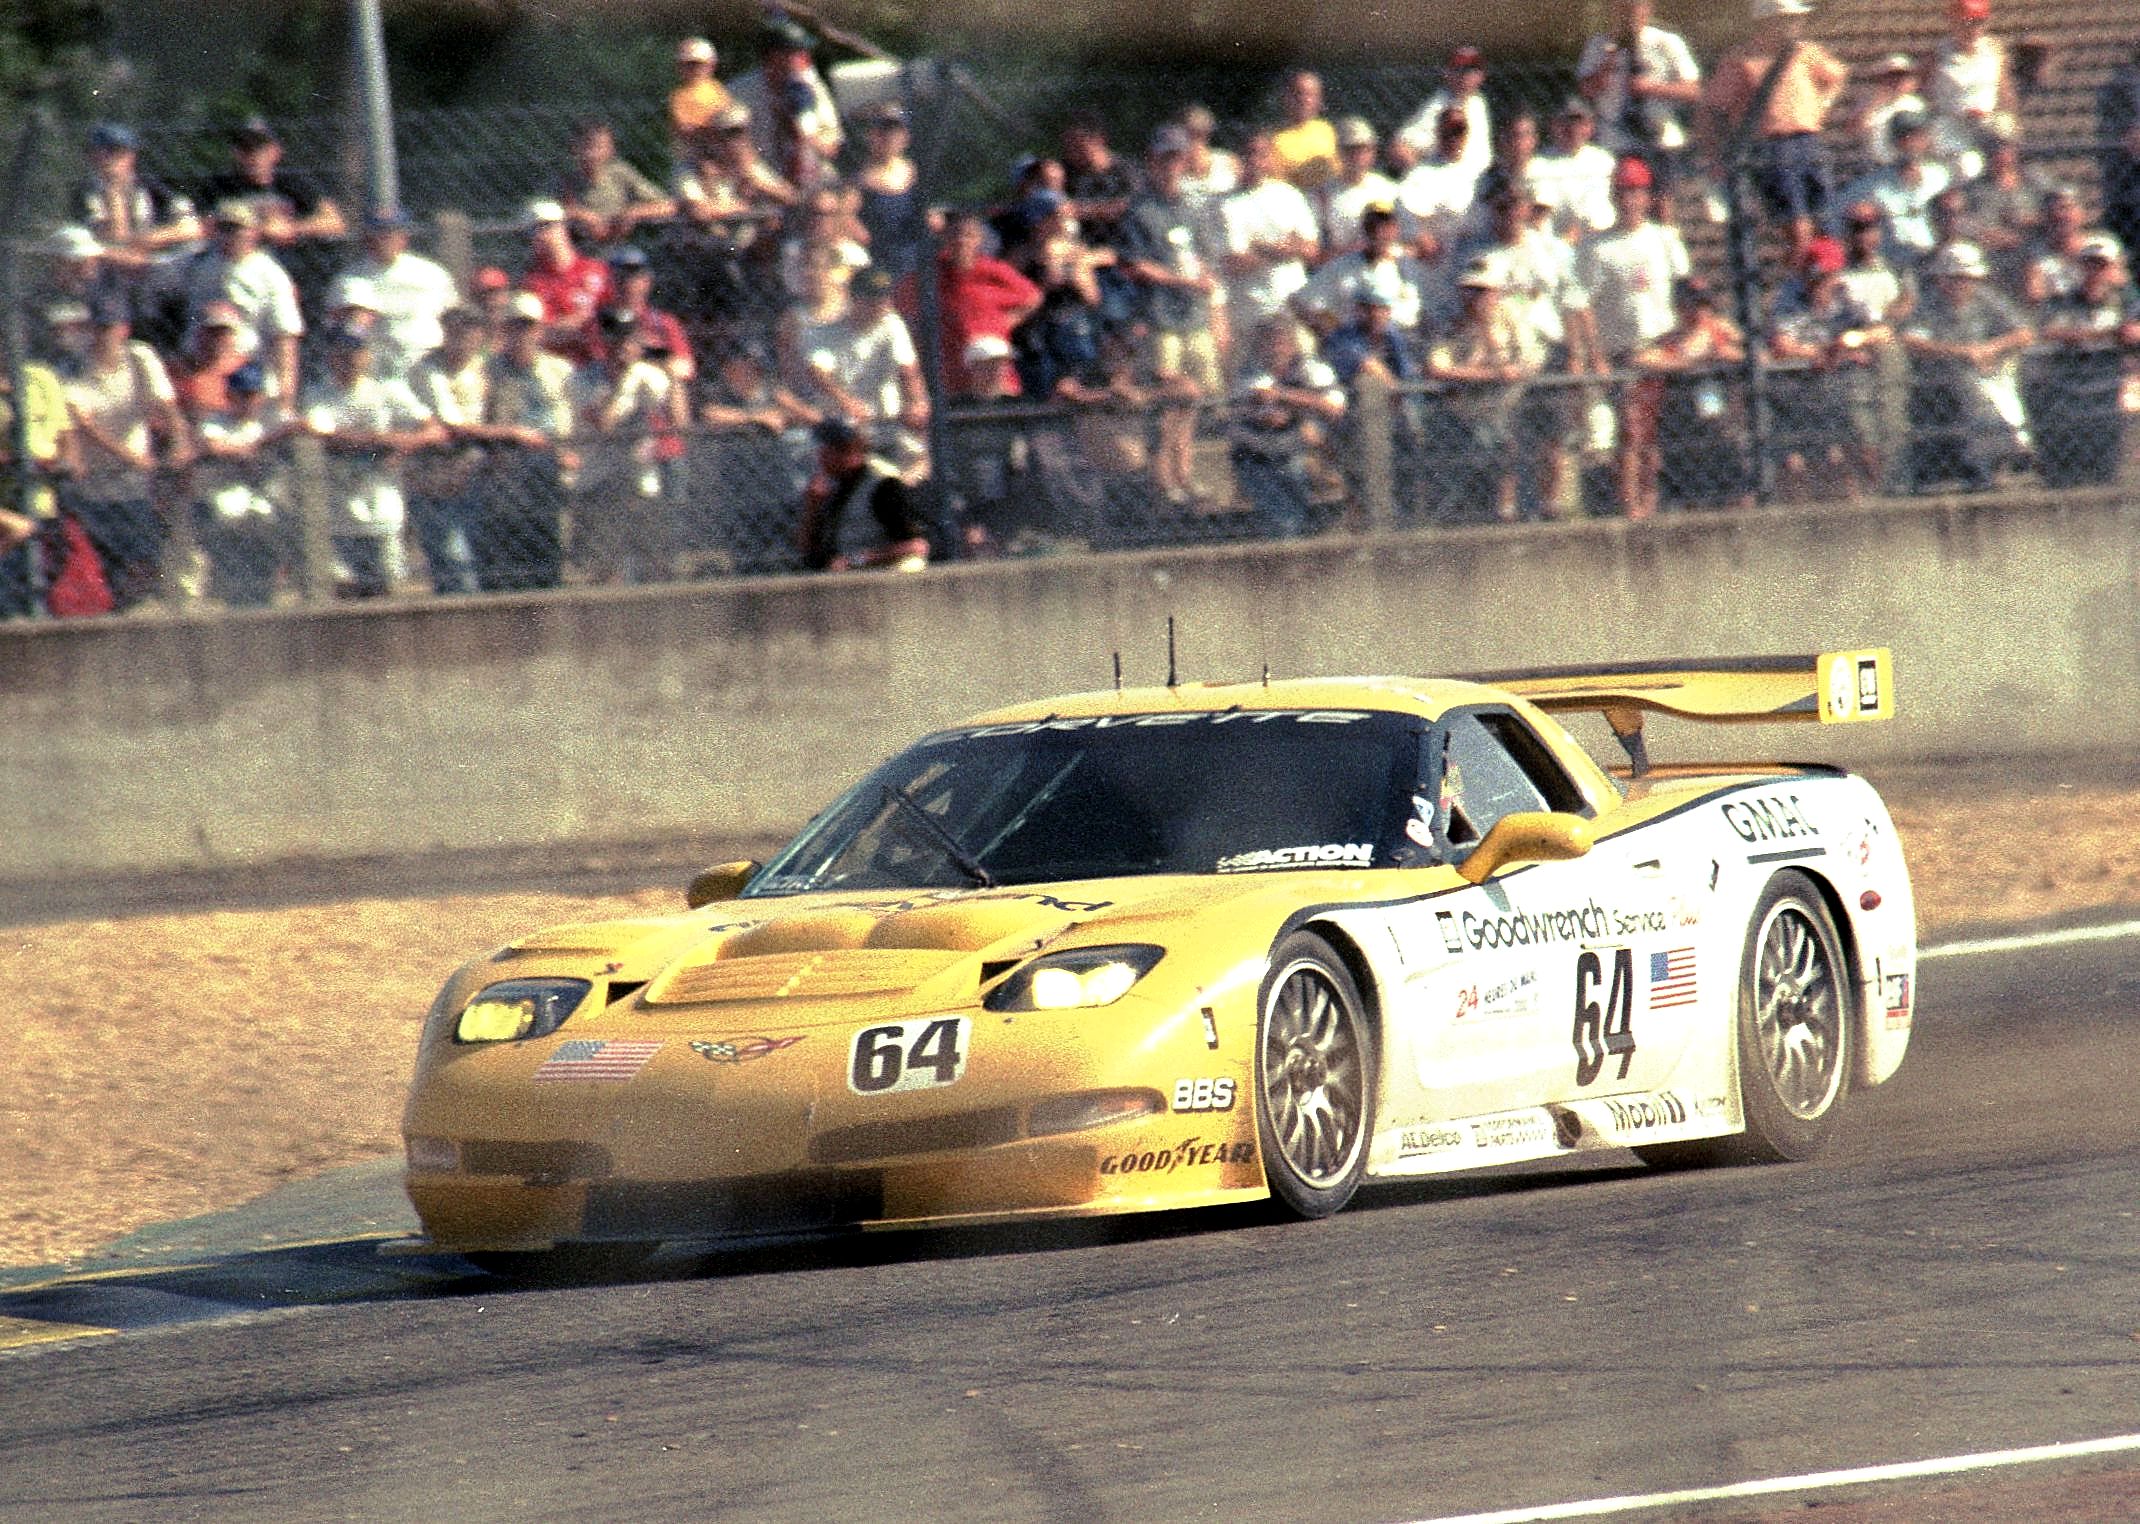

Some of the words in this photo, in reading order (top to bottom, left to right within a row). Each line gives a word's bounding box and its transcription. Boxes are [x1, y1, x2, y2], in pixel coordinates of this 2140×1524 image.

[1721, 795, 1819, 842] GMAC
[1250, 842, 1374, 865] ACTION
[1463, 896, 1609, 950] Goodwrench
[1456, 984, 1479, 1018] 24
[1572, 949, 1636, 1087] 64
[852, 1018, 960, 1092] 64
[1172, 1077, 1237, 1113] BBS
[1602, 1096, 1667, 1131] Mobil
[1101, 1136, 1256, 1174] GOODYEAR
